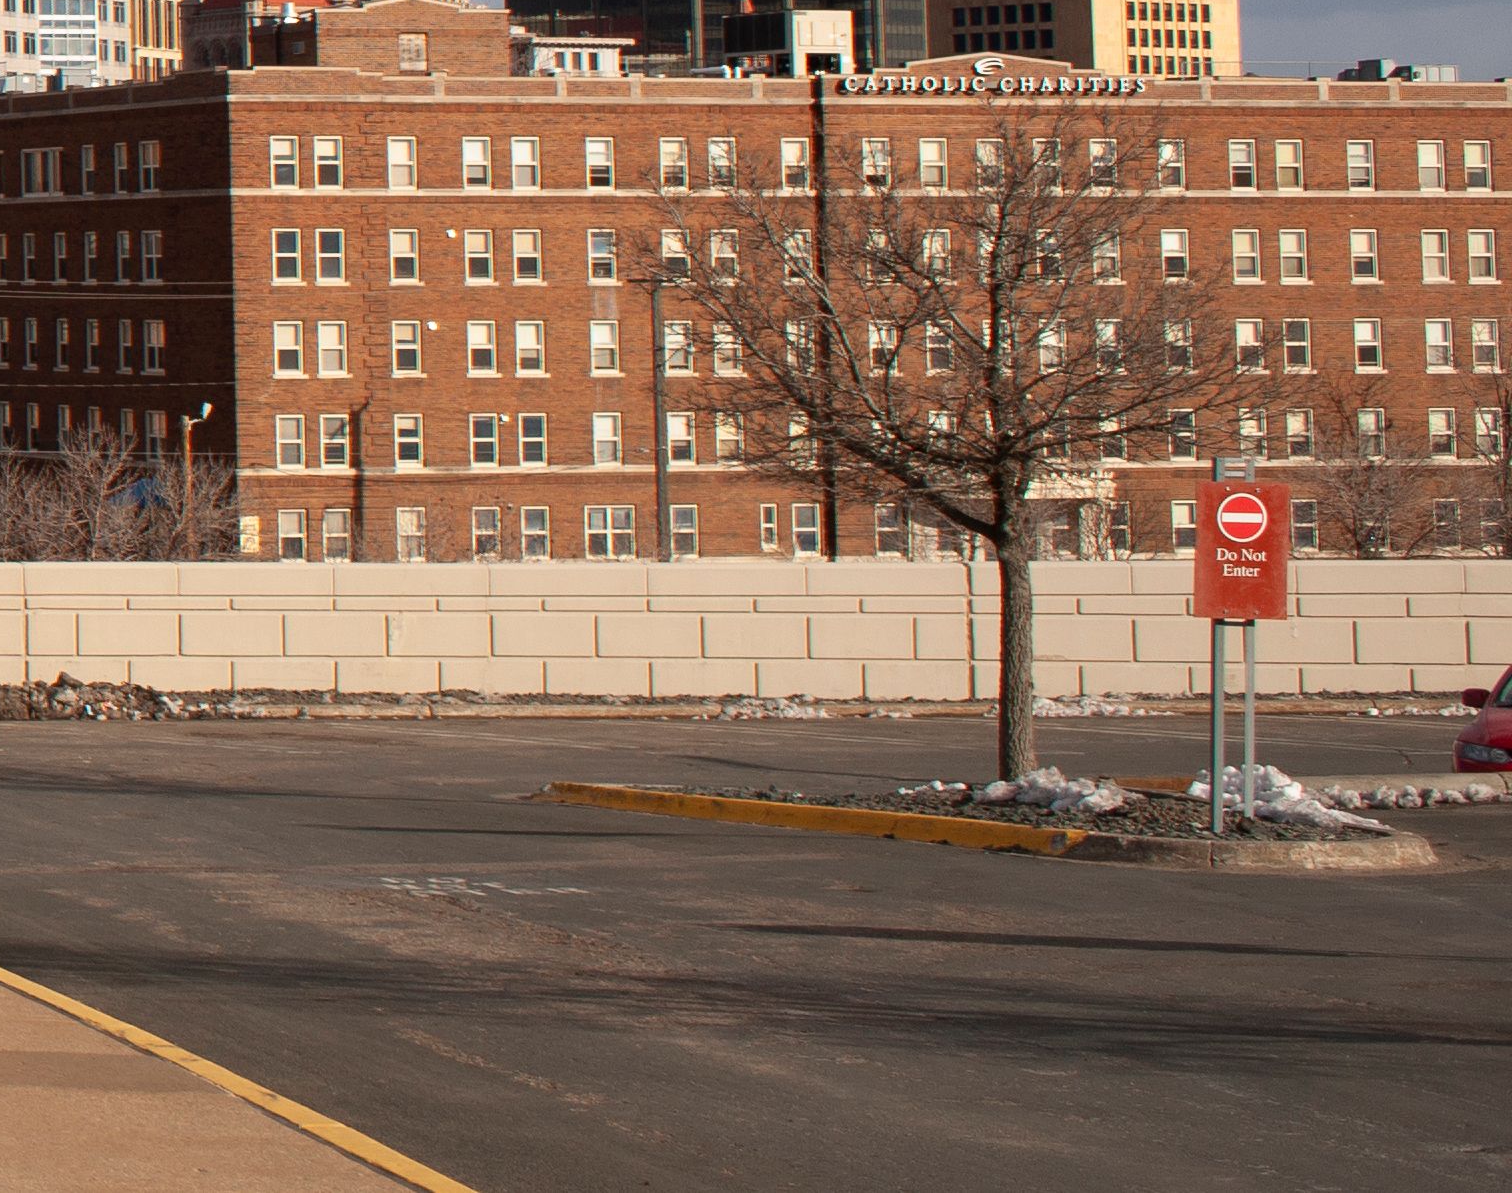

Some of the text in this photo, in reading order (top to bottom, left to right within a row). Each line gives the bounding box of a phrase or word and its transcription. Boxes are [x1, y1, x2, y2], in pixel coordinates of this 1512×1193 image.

[844, 76, 1146, 93] CATHOLIC CHARITIES
[1216, 547, 1267, 562] Do Not
[1222, 563, 1261, 577] Enter
